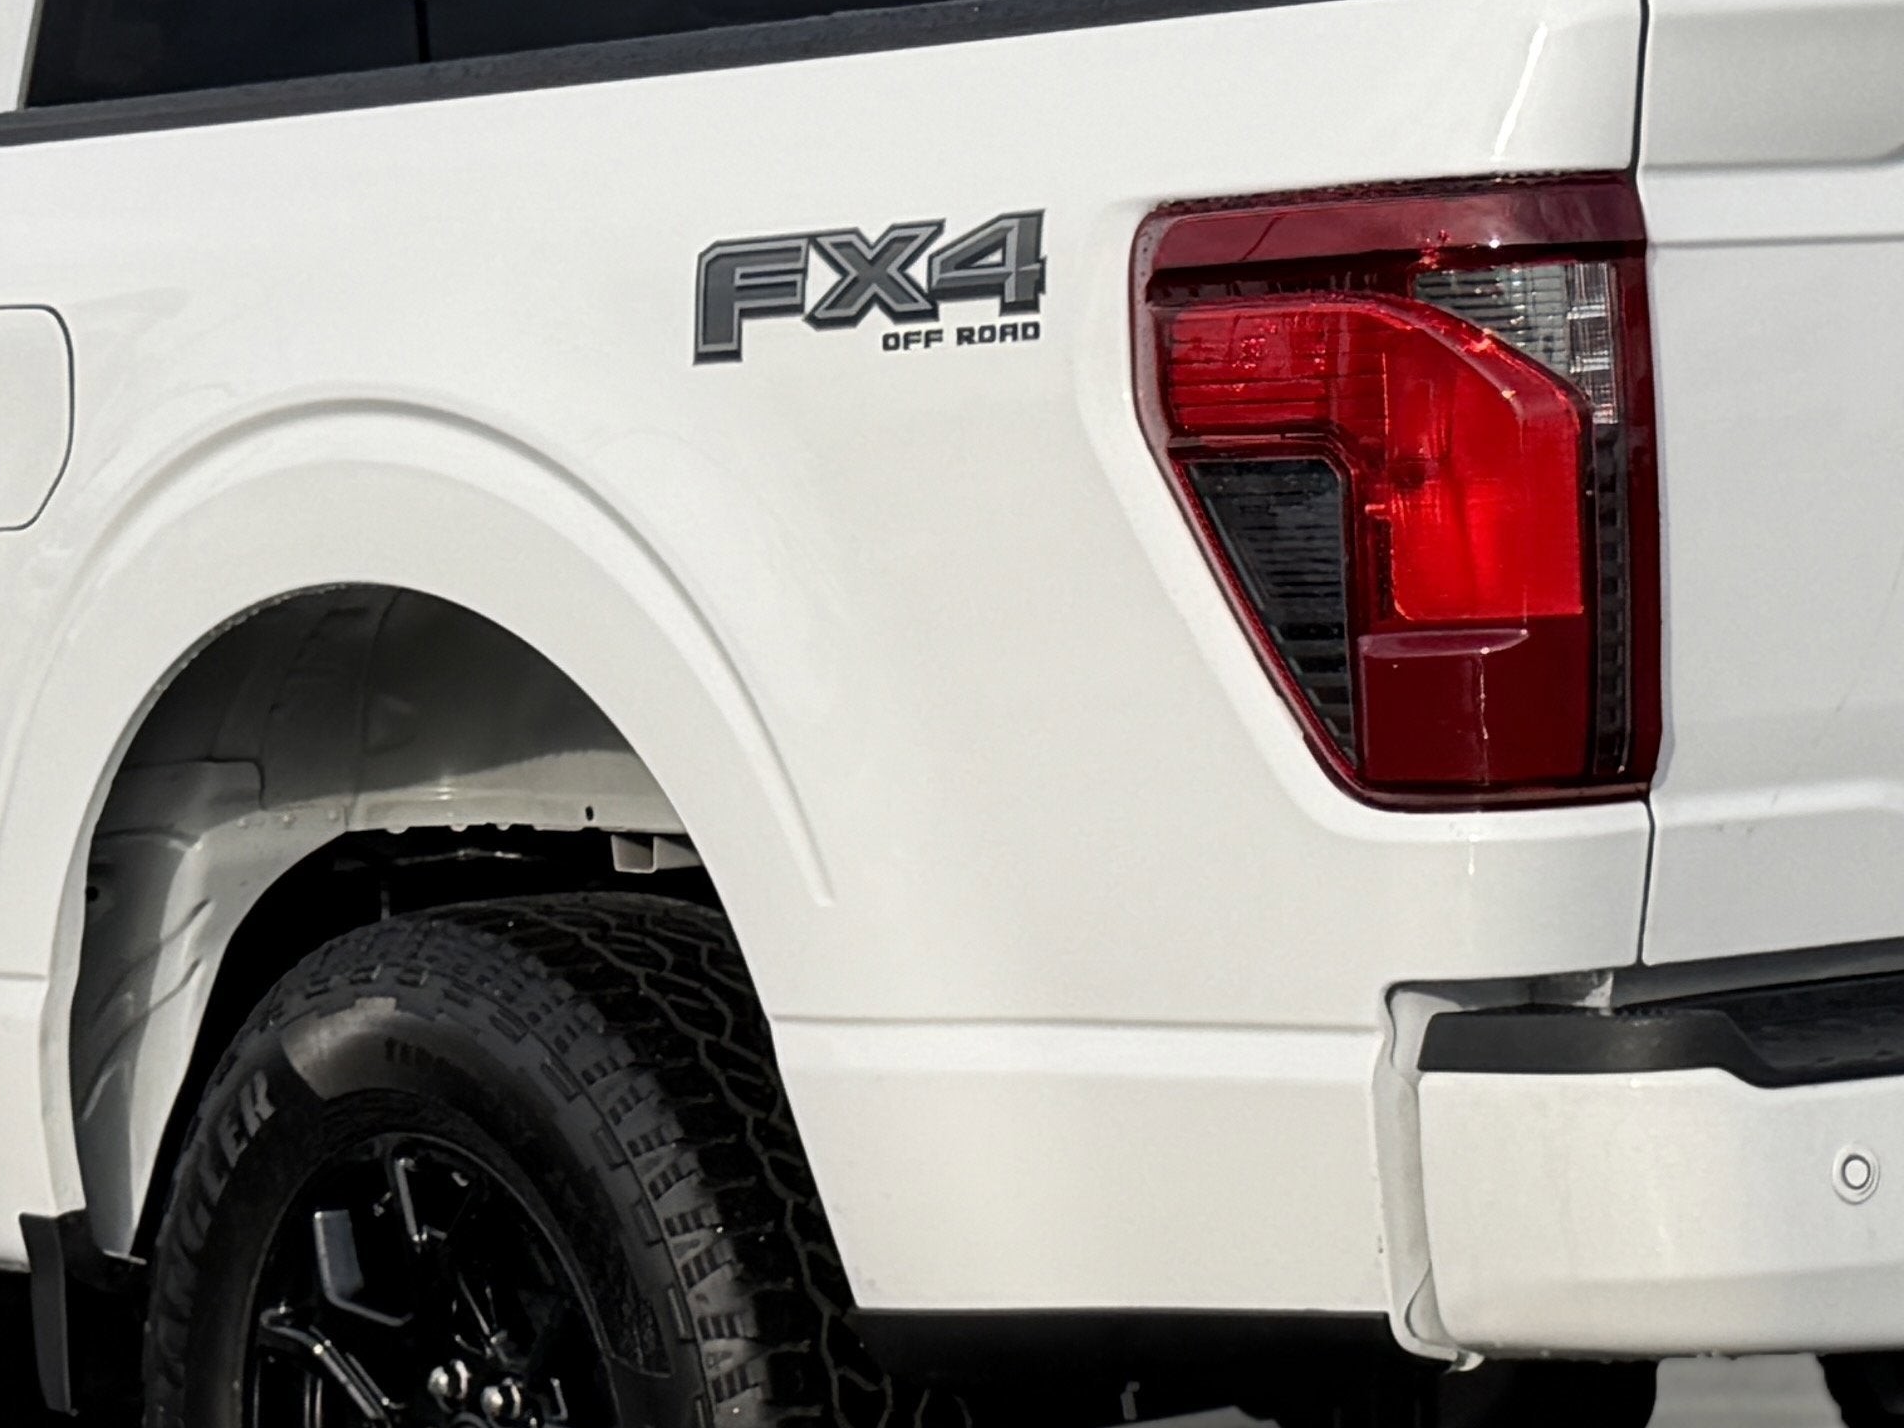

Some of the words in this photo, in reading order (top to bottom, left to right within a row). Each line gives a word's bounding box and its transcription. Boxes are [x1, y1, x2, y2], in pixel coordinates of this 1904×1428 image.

[693, 209, 1046, 366] FX4
[881, 329, 944, 351] OFF
[956, 321, 1041, 347] ROAD
